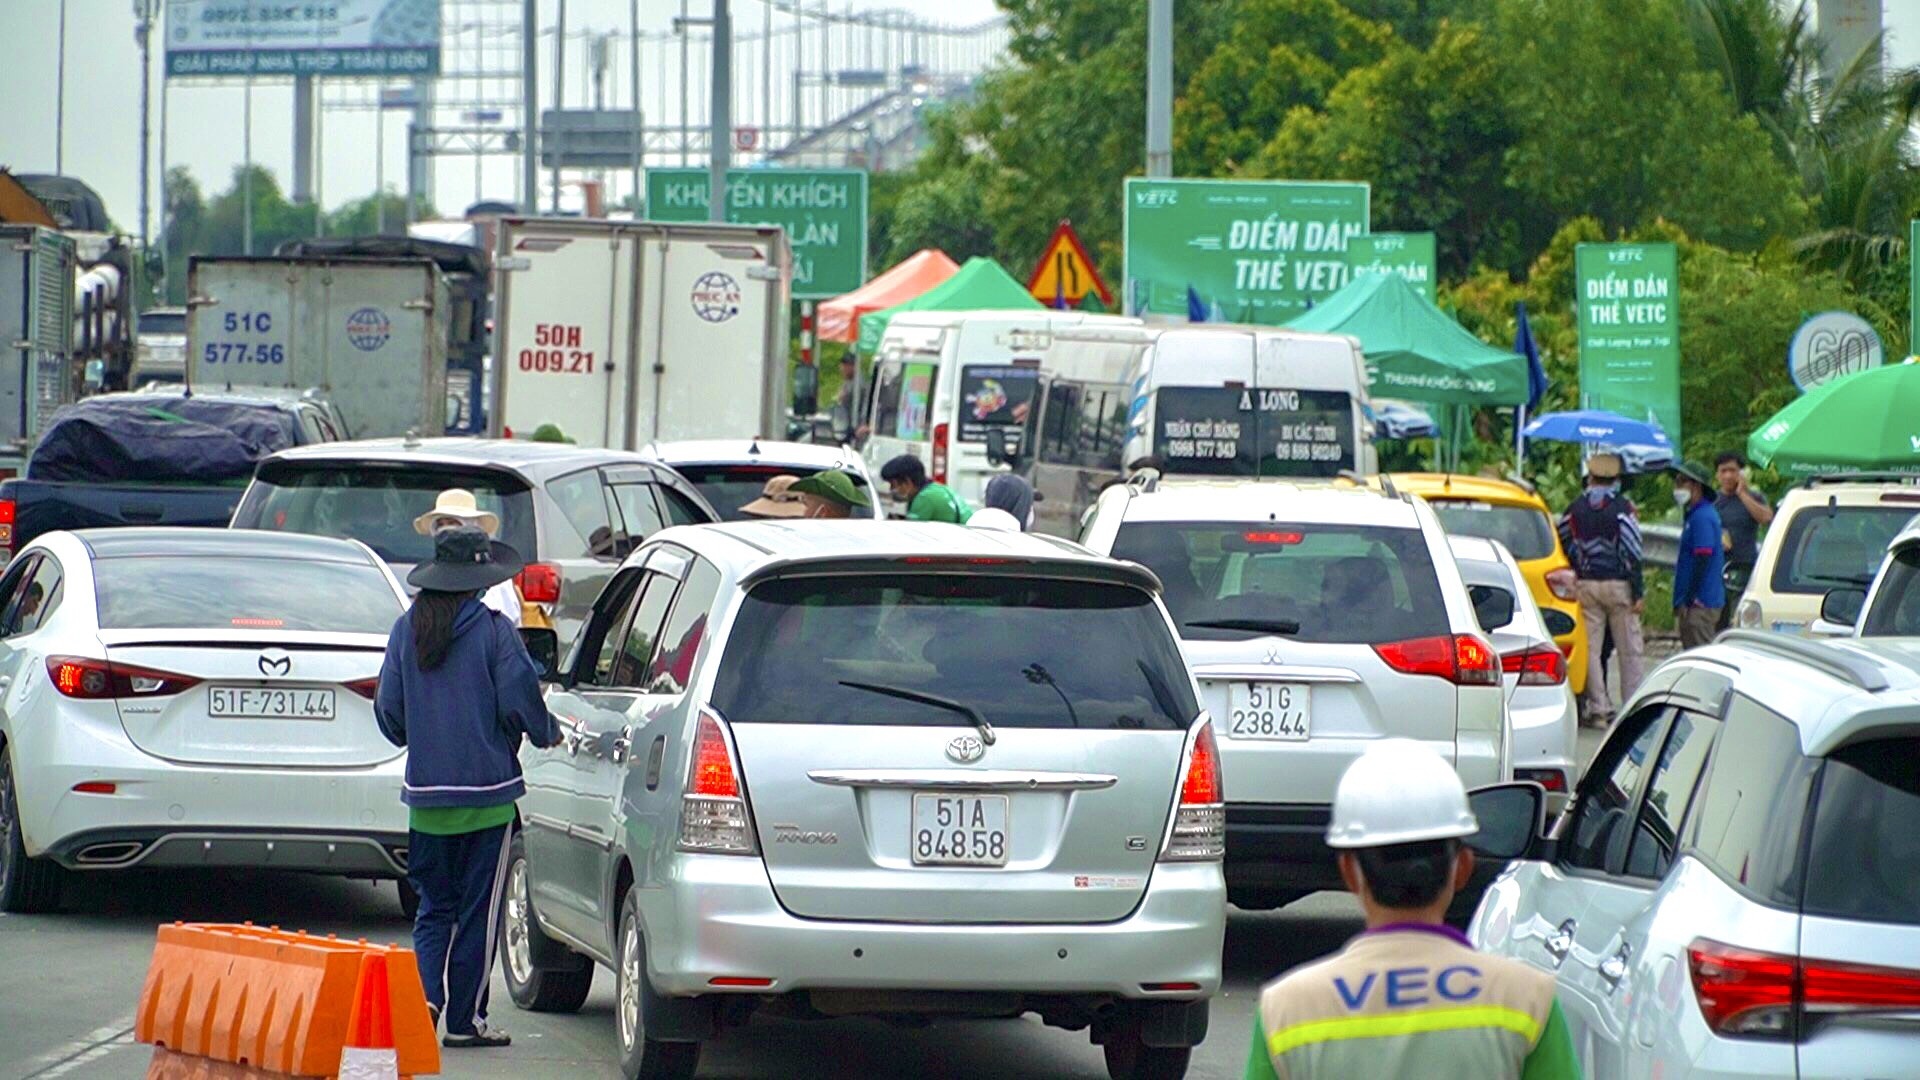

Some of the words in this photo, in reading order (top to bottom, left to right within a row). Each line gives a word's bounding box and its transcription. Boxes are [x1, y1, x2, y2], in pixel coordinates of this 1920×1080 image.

[772, 175, 848, 208] KHÍCH
[224, 312, 272, 333] 51C
[1625, 303, 1666, 324] VETC
[535, 324, 581, 347] 50H
[204, 343, 284, 364] 577.56
[519, 349, 594, 374] 009.21
[1807, 329, 1870, 386] 60
[1239, 390, 1253, 411] A
[1259, 391, 1300, 411] LONG
[212, 689, 330, 715] 51F-731.44
[1249, 684, 1291, 709] 51G
[1232, 710, 1306, 735] 238.44
[937, 798, 985, 828] 51A
[917, 829, 1005, 859] 848.58
[1333, 964, 1483, 1011] VEC
